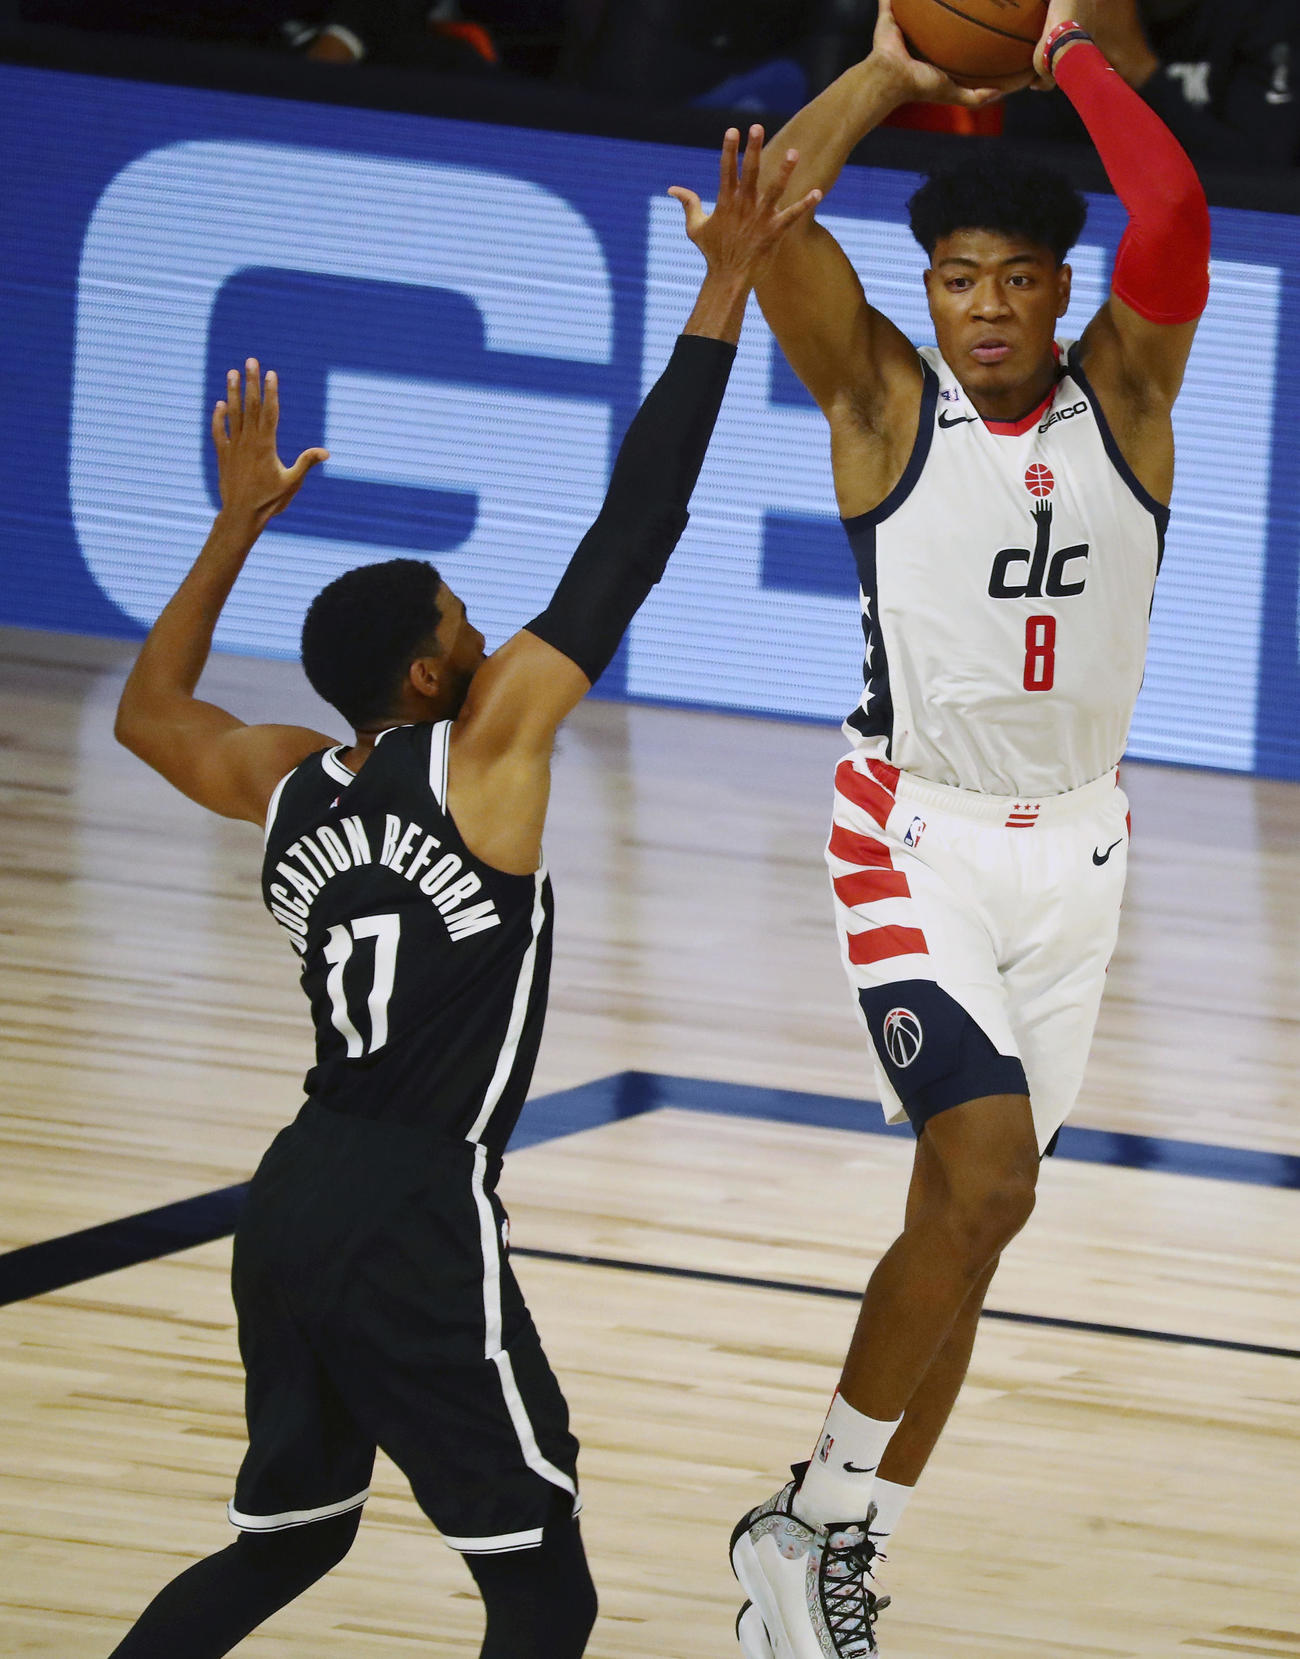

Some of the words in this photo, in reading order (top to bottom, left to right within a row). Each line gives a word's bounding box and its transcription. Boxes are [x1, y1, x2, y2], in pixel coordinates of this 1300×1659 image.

[68, 139, 1300, 772] GEI
[1038, 401, 1088, 434] GEICO
[1022, 614, 1056, 692] 8
[268, 814, 372, 975] DUCATION
[379, 813, 501, 943] REFORM
[322, 913, 401, 1059] 17
